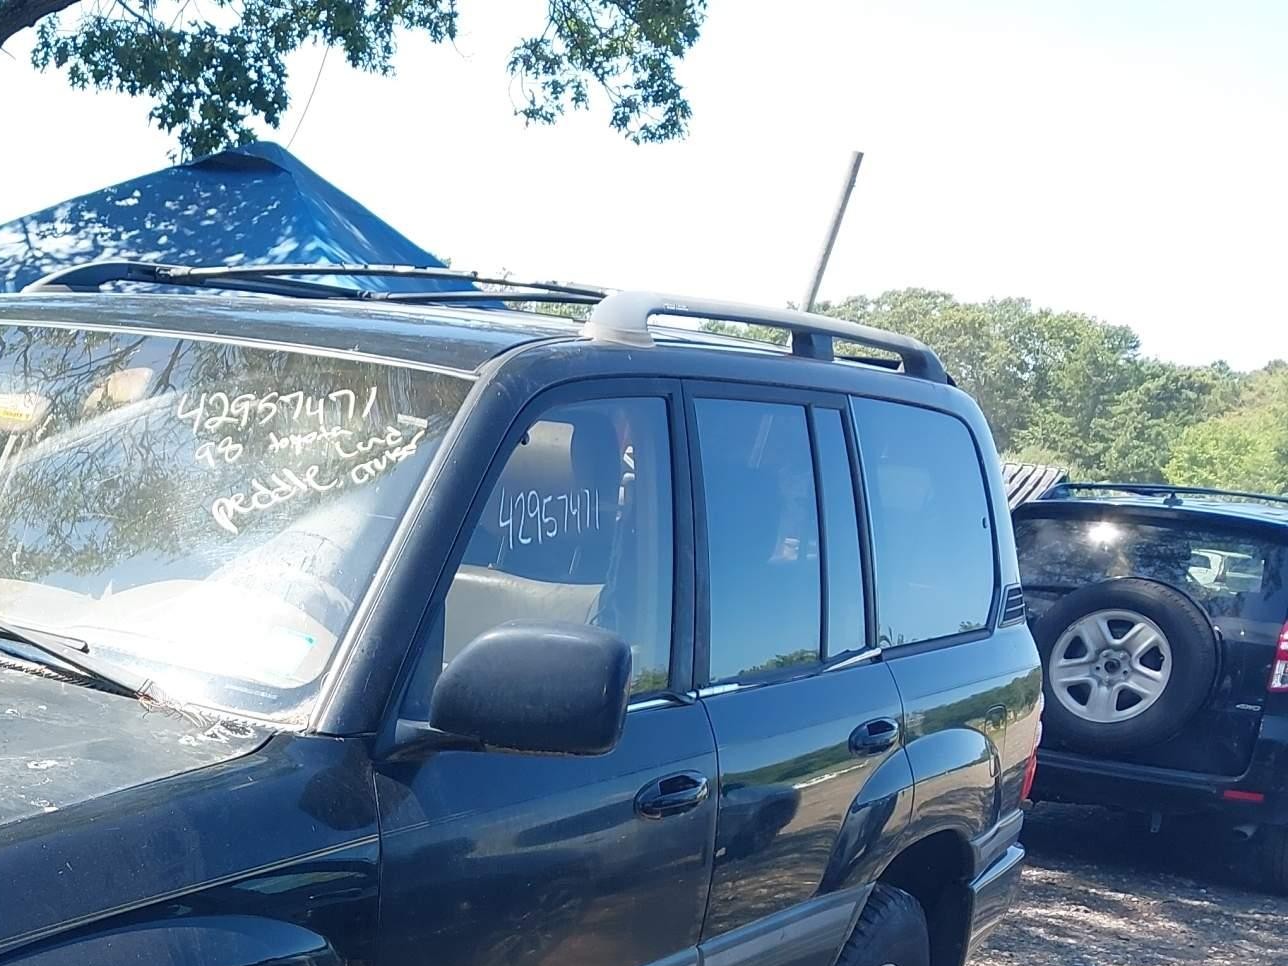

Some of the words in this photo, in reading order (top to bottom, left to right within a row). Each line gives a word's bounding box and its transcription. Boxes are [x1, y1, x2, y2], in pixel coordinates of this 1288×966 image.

[177, 386, 378, 434] 42957471
[195, 436, 244, 467] 98
[499, 487, 600, 549] 42957471
